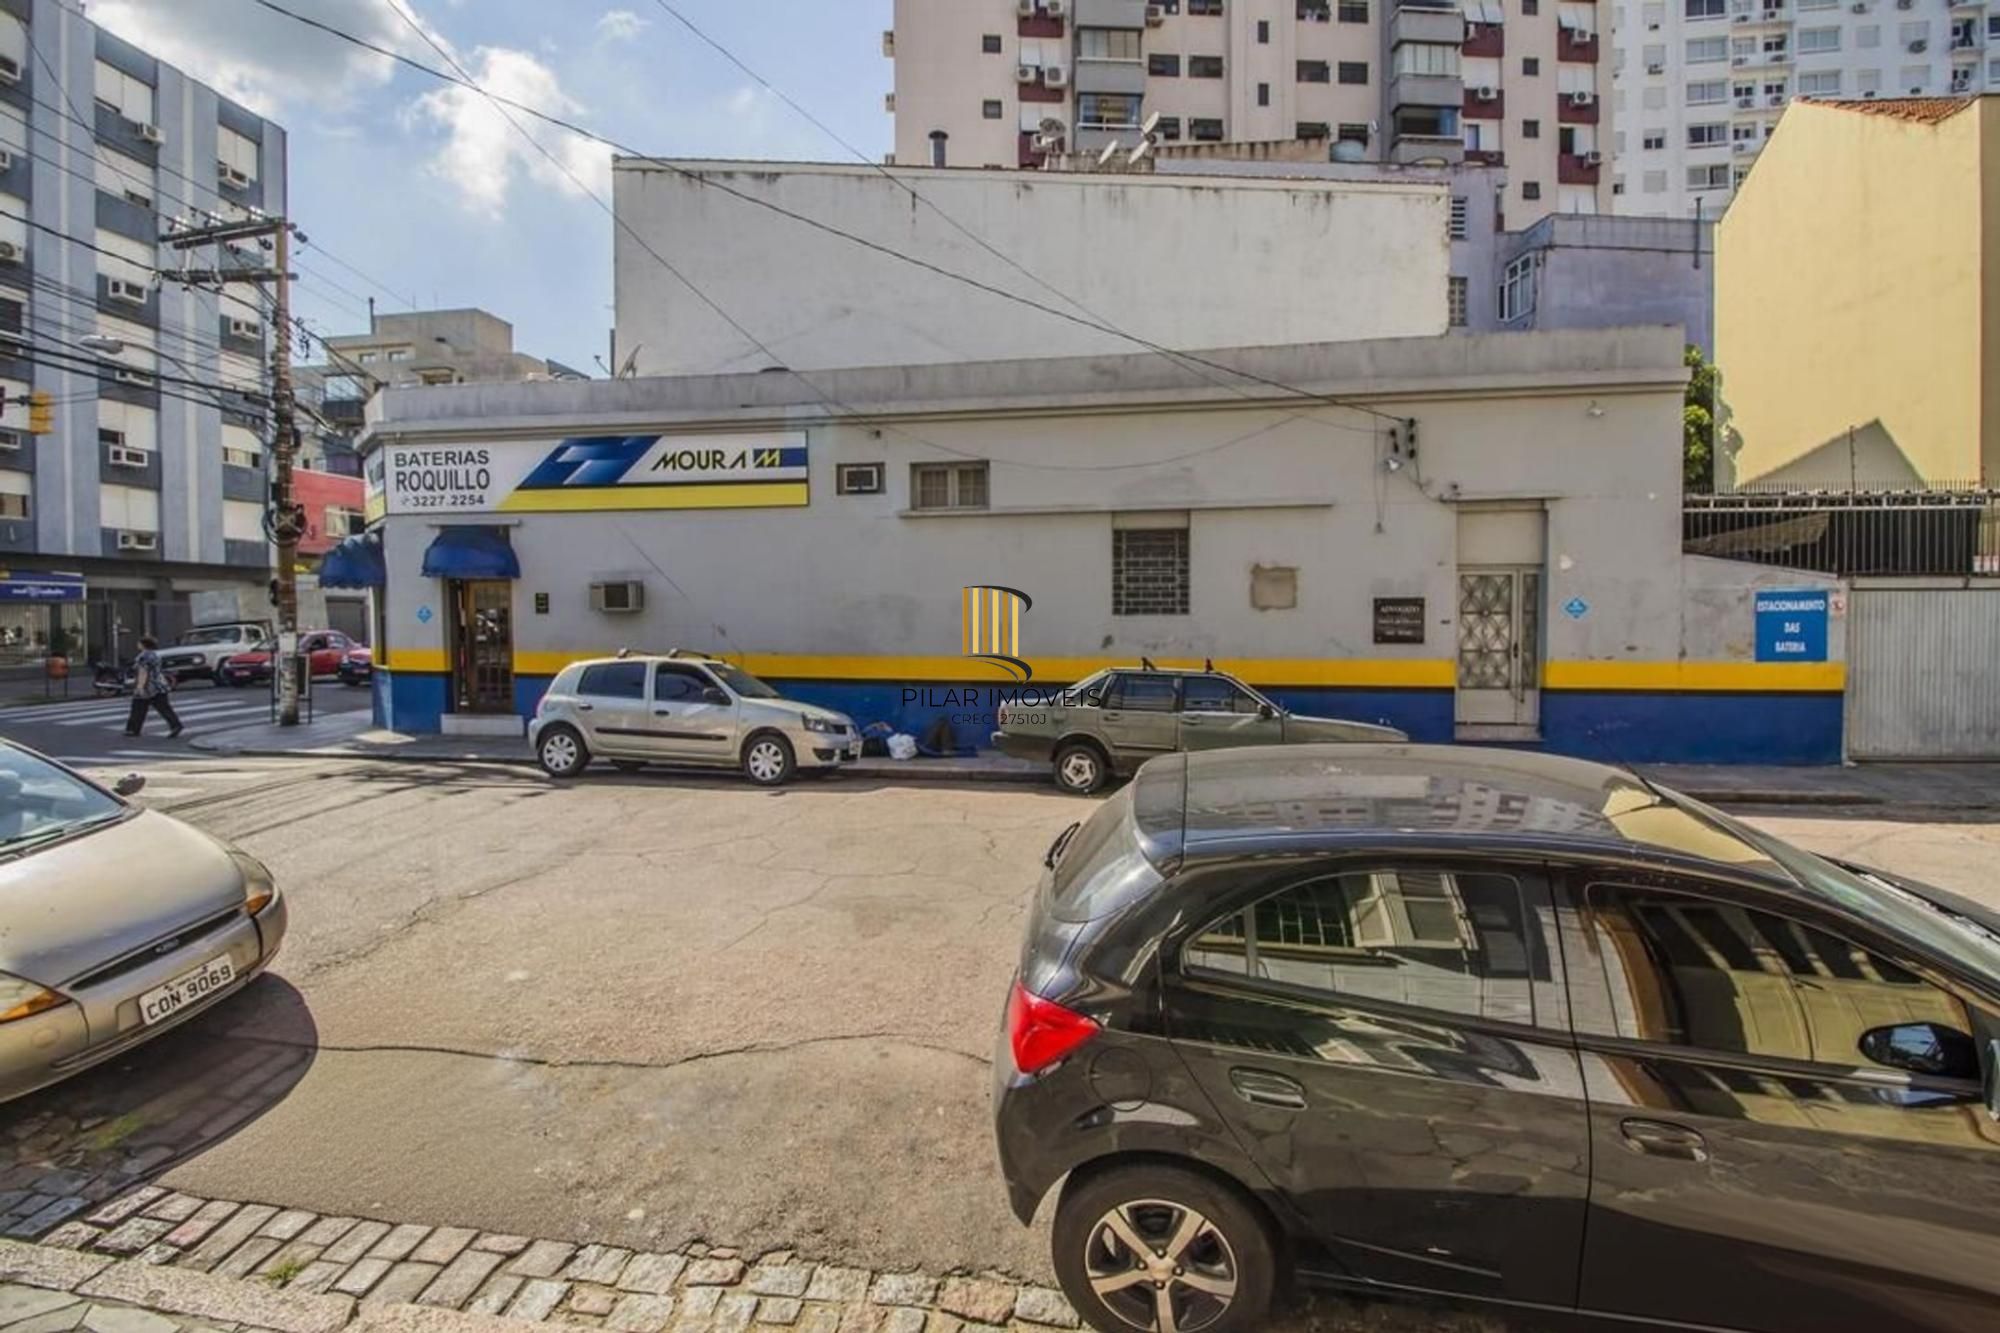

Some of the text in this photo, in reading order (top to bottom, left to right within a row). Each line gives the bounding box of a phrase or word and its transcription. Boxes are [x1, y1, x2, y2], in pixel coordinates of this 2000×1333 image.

[394, 450, 489, 468] BATERIAS
[651, 450, 747, 471] MOURA
[395, 468, 490, 493] ROQUILLO
[412, 494, 485, 507] 3227.2254
